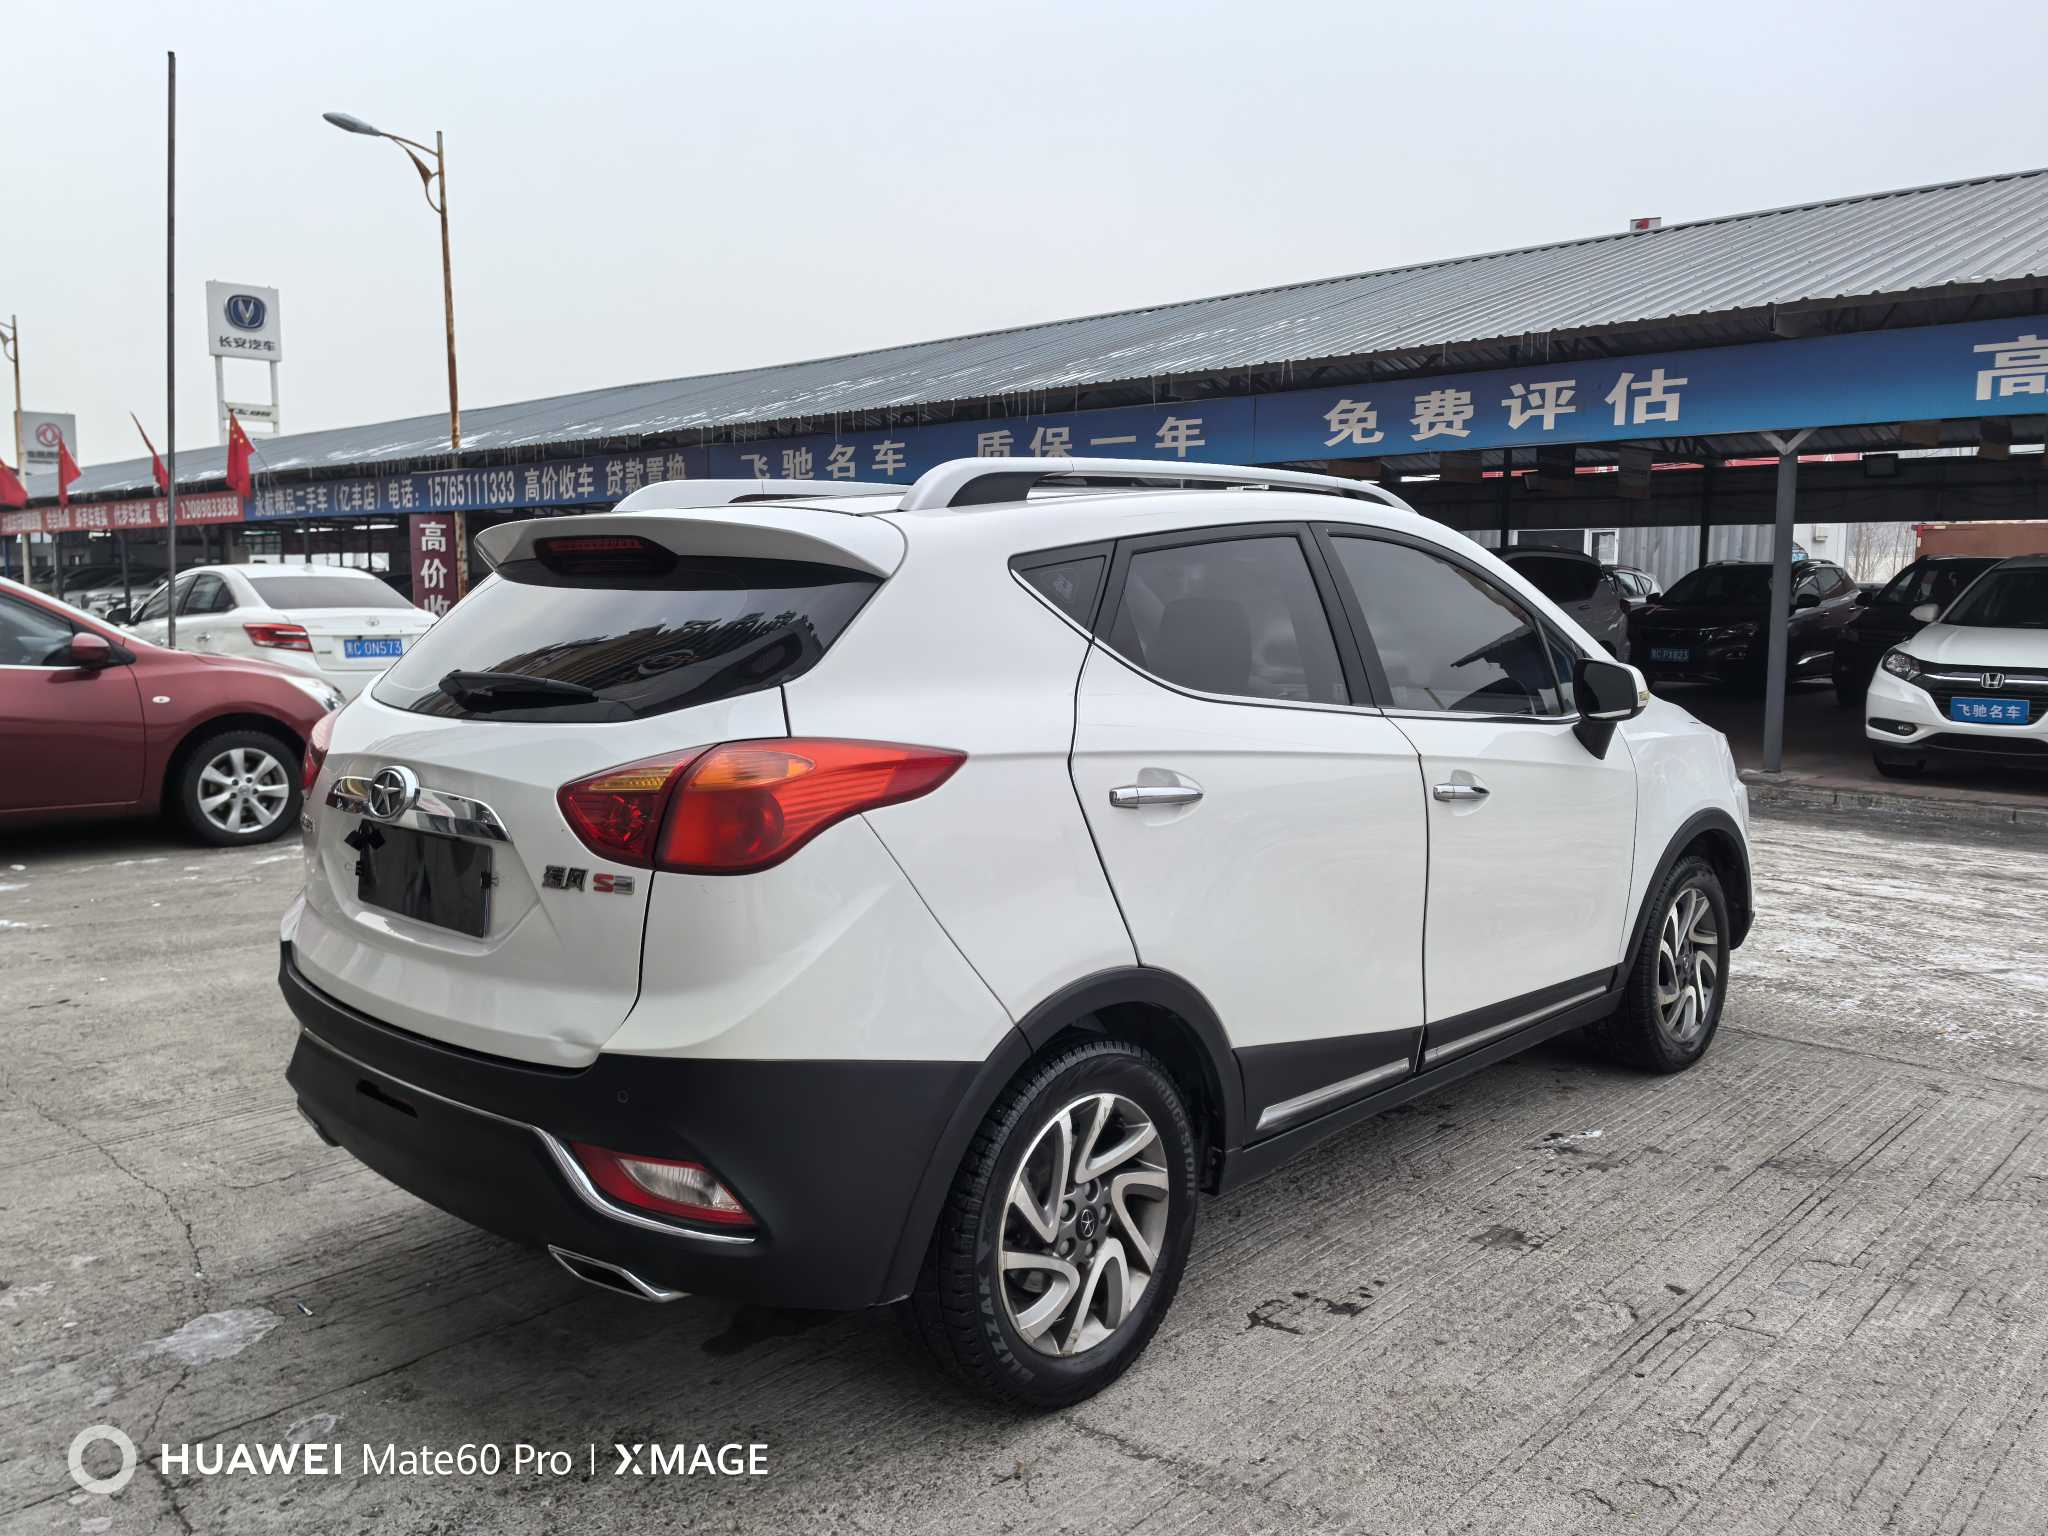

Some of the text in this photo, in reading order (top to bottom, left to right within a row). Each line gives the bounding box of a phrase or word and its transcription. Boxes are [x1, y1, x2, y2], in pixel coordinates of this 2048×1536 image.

[219, 335, 276, 351] 长安汽车
[740, 334, 2048, 479] 飞驰名车 质保一年 免费评估 高
[427, 470, 515, 507] 15765111333
[525, 463, 595, 502] 高价收车
[606, 452, 687, 496] 贷款置换
[1956, 704, 2021, 719] 飞驰名车
